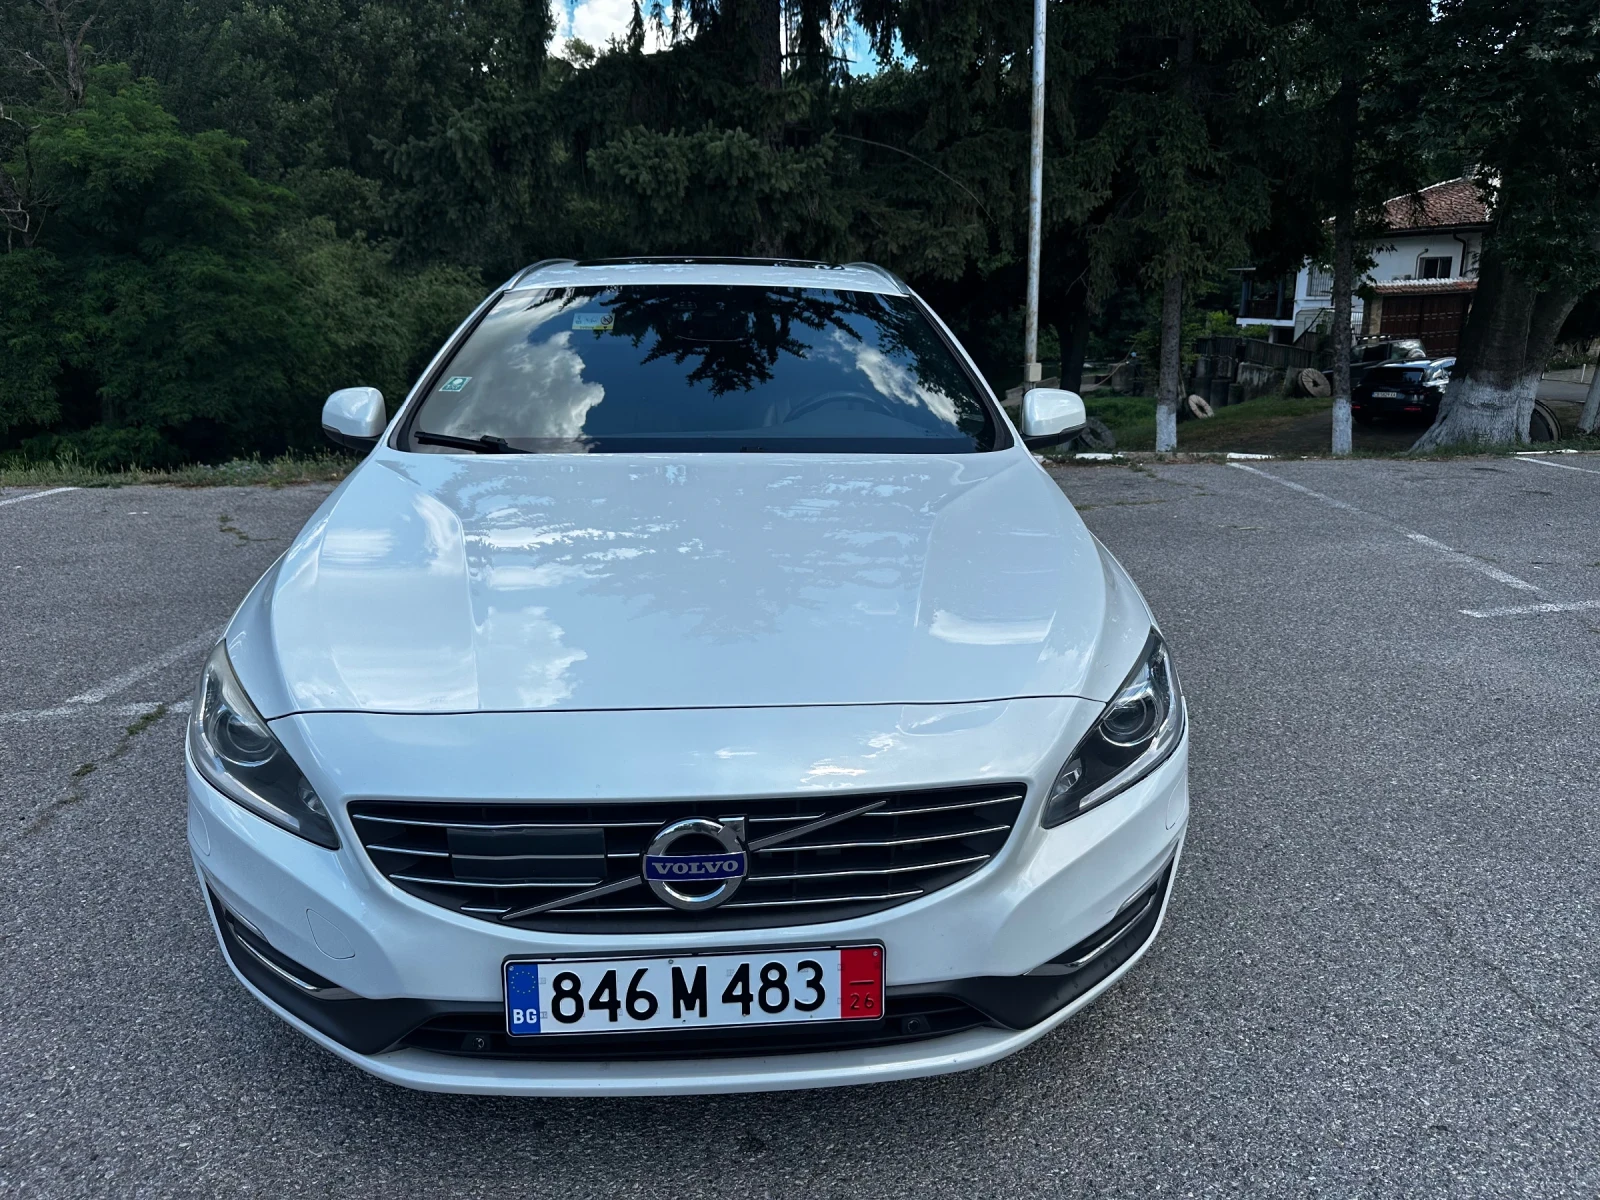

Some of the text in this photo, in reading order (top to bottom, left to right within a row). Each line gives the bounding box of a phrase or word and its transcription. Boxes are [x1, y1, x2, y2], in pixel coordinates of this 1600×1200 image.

[652, 860, 739, 875] VOLVO
[551, 959, 826, 1024] 846 M 483
[850, 991, 875, 1010] 26
[512, 1008, 537, 1024] BG
